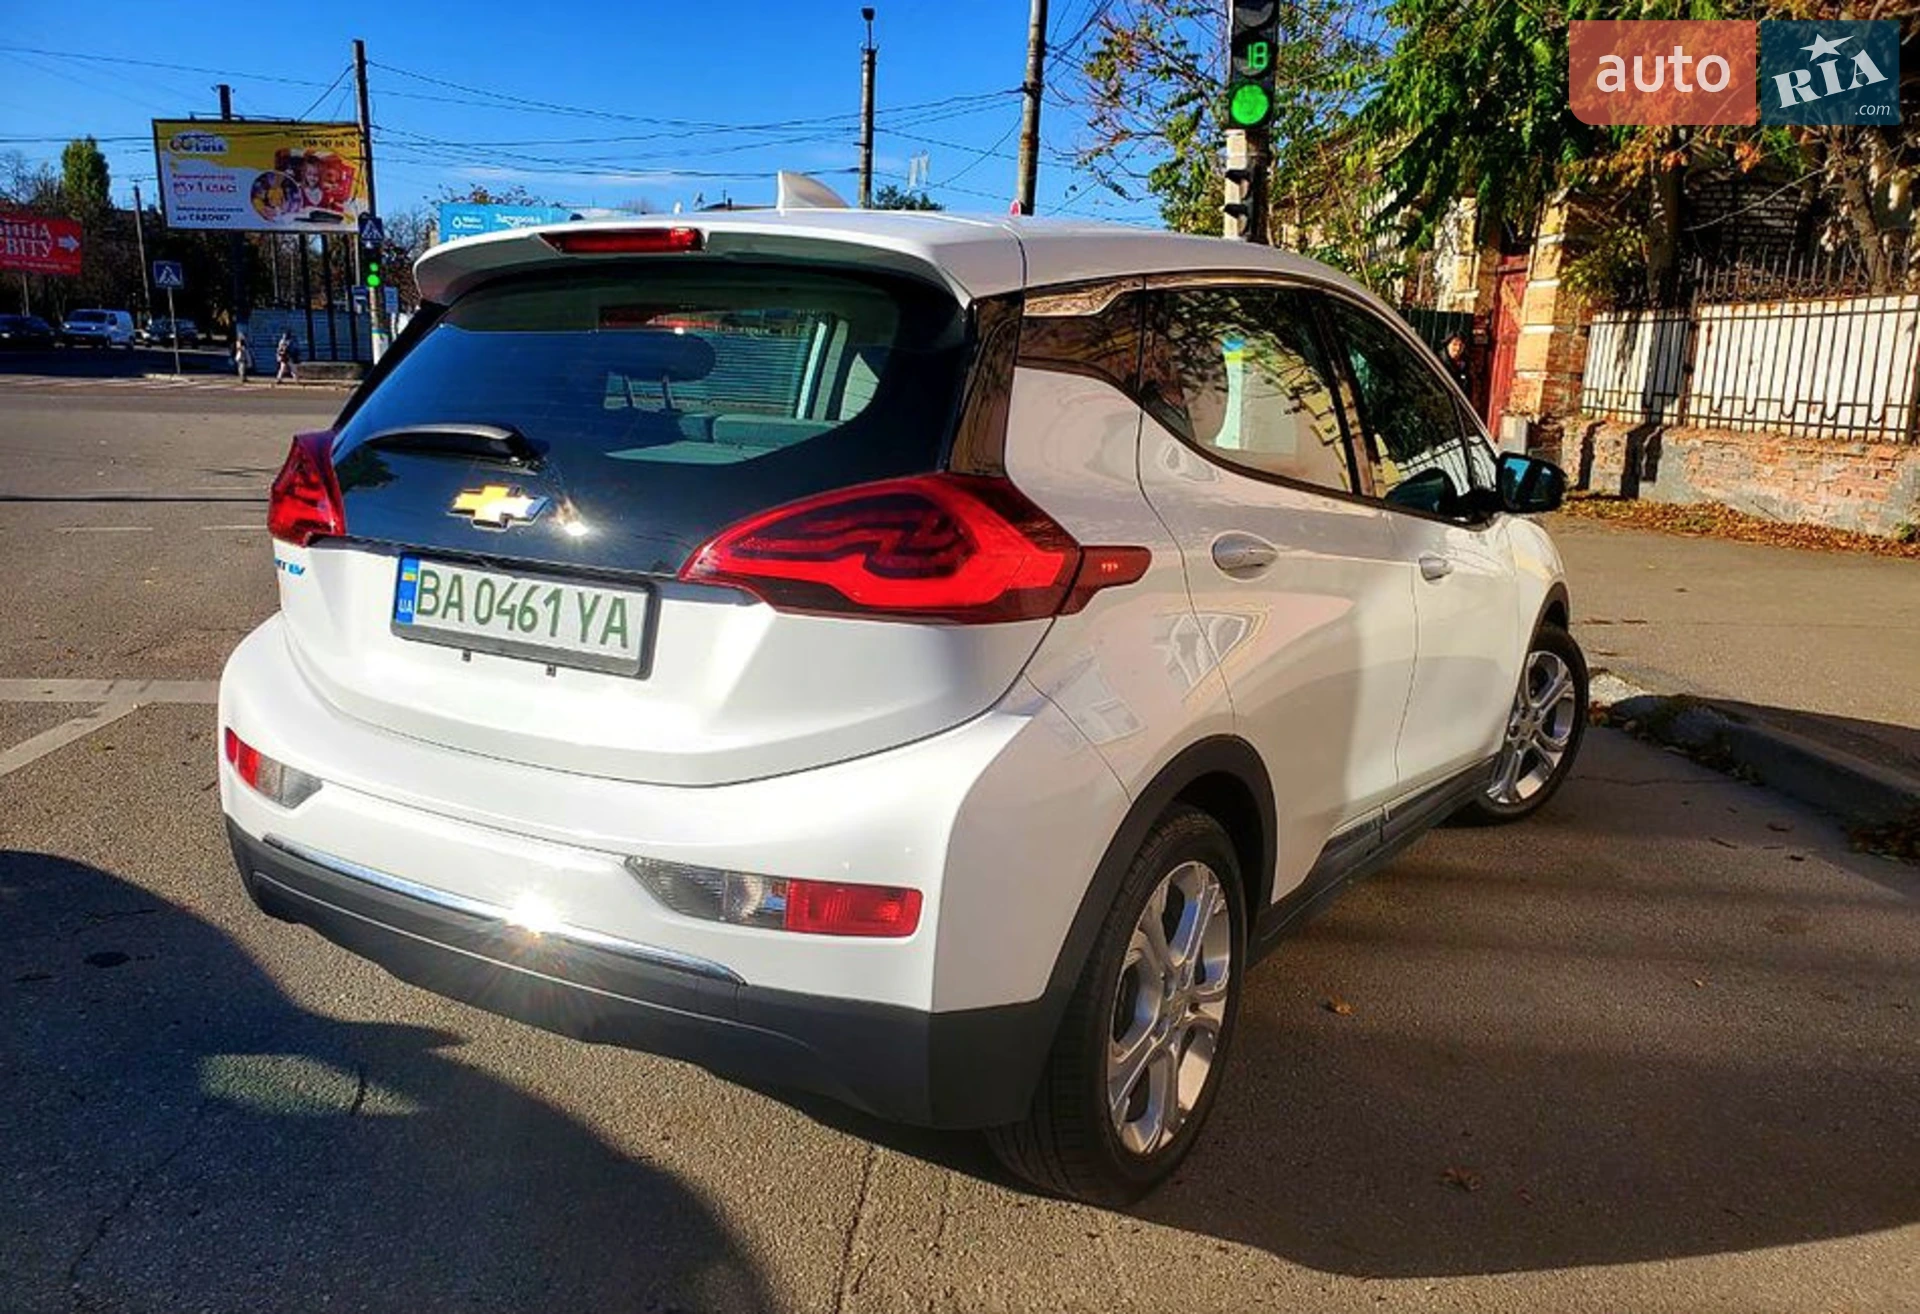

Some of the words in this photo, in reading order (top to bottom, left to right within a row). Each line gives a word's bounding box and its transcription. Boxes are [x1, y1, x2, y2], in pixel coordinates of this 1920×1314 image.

[1247, 42, 1268, 70] 18
[416, 569, 464, 622] BA
[474, 577, 563, 637] 0461
[577, 591, 628, 648] YA
